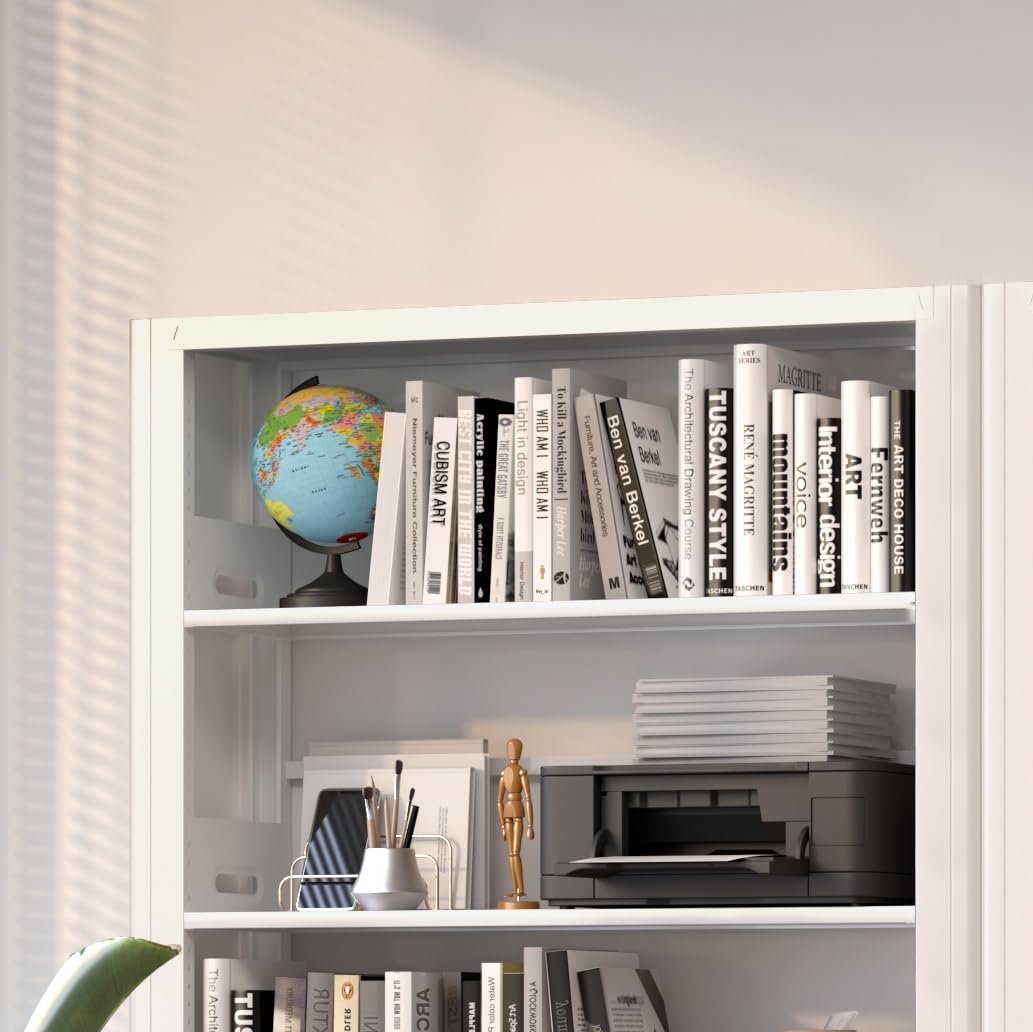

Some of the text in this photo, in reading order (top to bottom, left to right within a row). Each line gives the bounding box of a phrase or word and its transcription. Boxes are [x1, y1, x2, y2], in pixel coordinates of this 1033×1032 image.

[536, 409, 549, 432] WHO
[778, 363, 822, 392] MAGRITTE
[431, 441, 451, 526] CUBISM ART
[516, 400, 529, 496] Light in design
[536, 436, 549, 451] AM
[607, 414, 622, 450] Ben
[616, 453, 632, 486] van
[625, 489, 650, 546] Berkel
[682, 367, 695, 561] The Architectural Drawing Course
[708, 390, 728, 581] TUSCANY STYLE
[743, 424, 759, 537] RENÉ MAGRITTE
[845, 453, 863, 500] ART
[772, 433, 792, 572] mountains
[796, 461, 812, 529] voice
[817, 425, 841, 588] Interior design
[870, 447, 889, 543] Fernweh
[893, 420, 905, 575] THE ART DECO HOUSE
